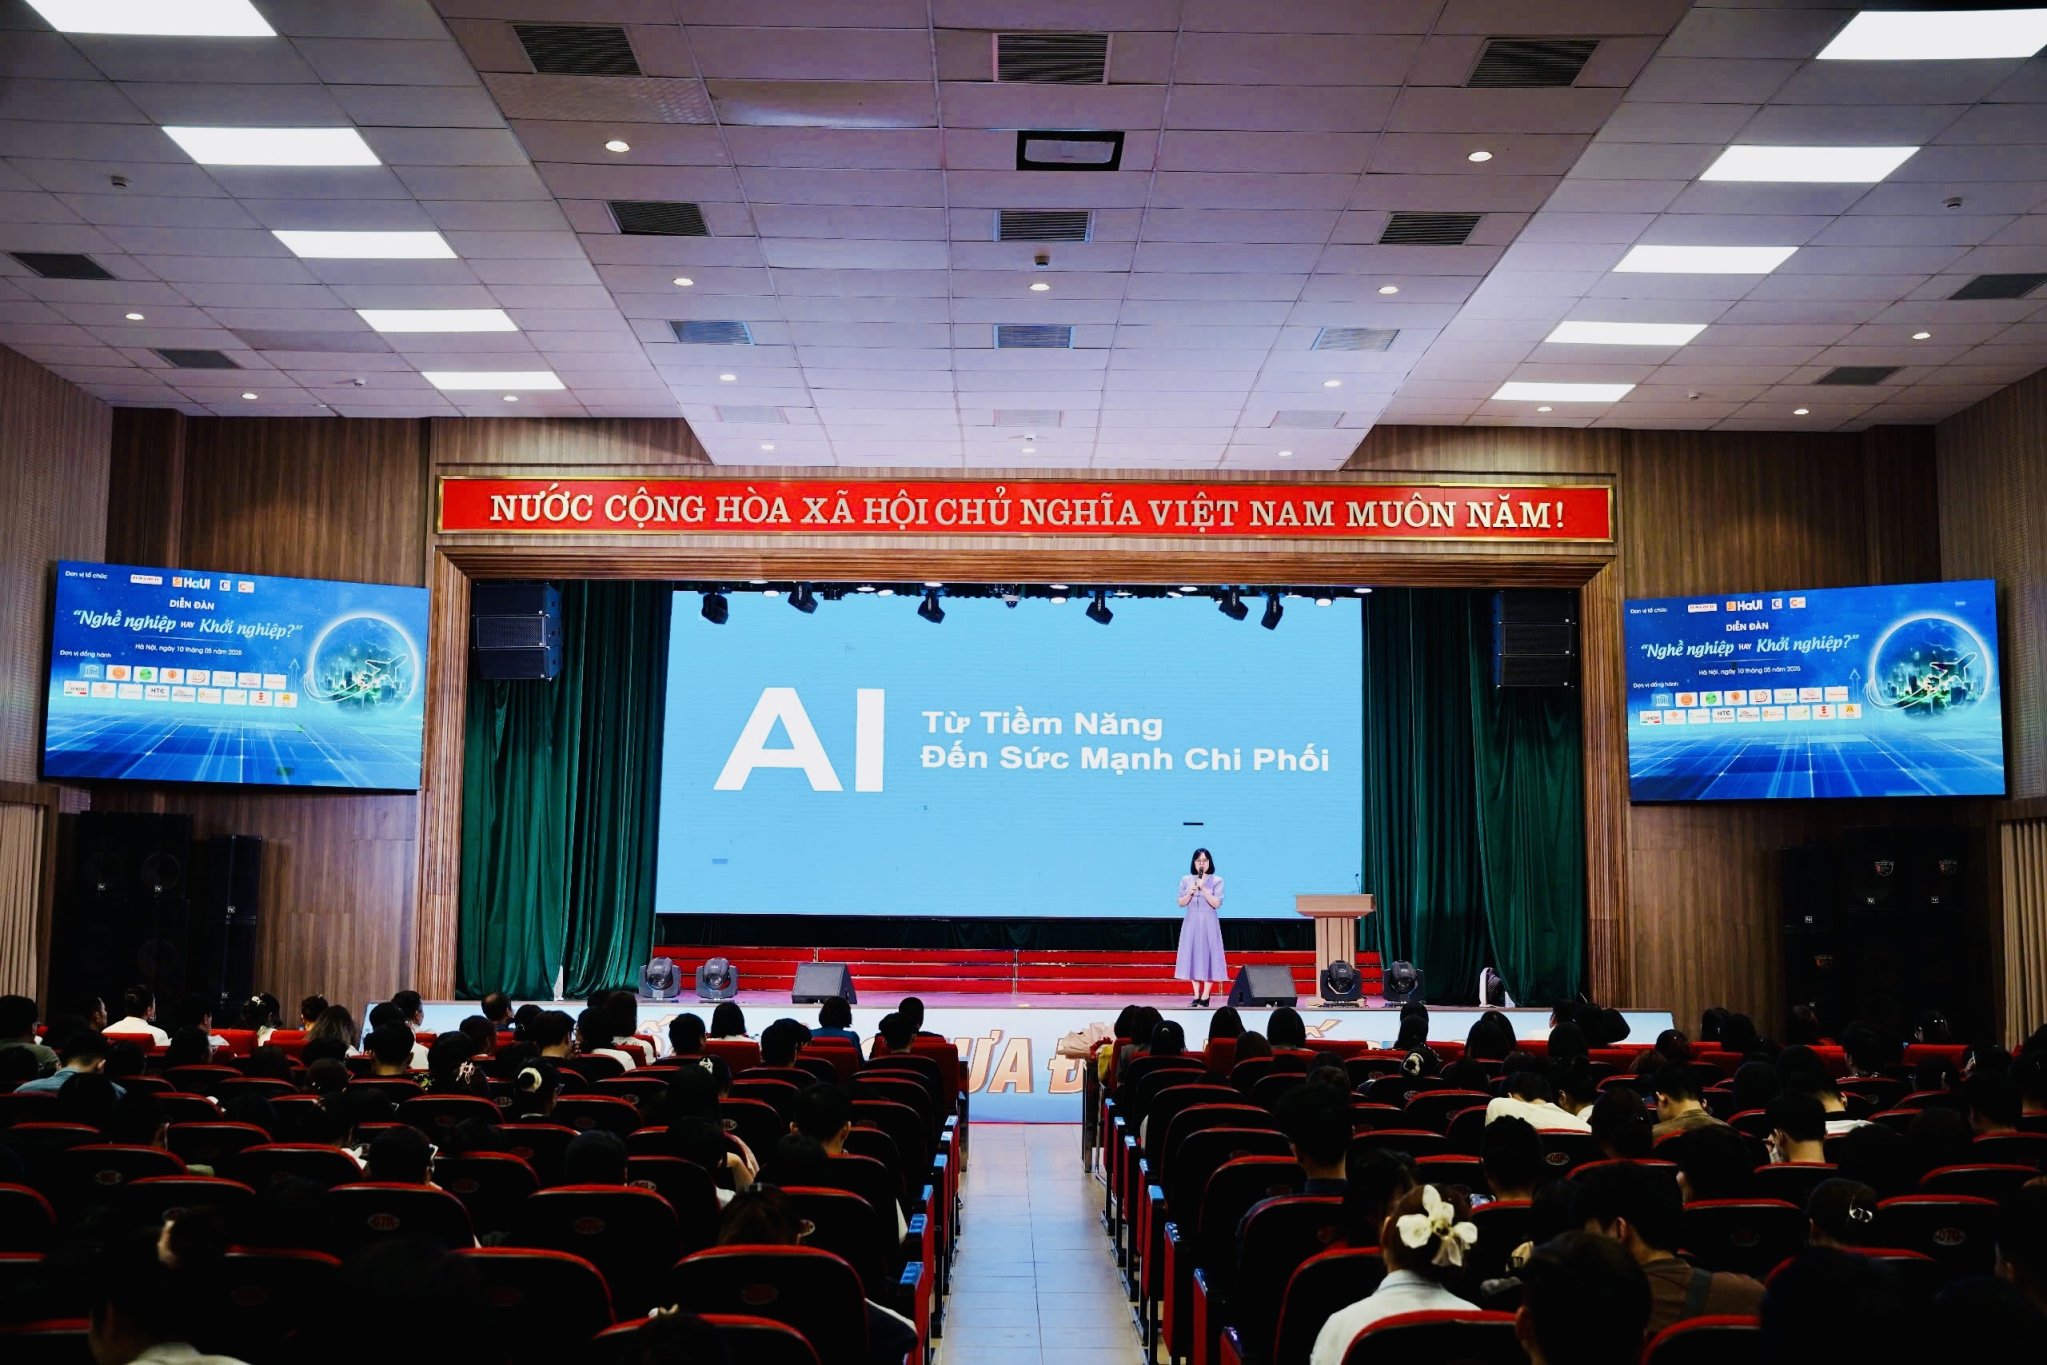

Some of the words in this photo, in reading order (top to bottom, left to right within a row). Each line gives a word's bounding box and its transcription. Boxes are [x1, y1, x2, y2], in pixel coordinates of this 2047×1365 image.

[490, 484, 593, 523] NƯỚC
[605, 488, 707, 530] CỘNG
[716, 486, 791, 523] HÒA
[799, 489, 854, 524] XÃ
[863, 489, 930, 530] HỘI
[935, 485, 1011, 525] CHỦ
[1019, 492, 1140, 526] NGHĨA
[1148, 492, 1239, 533] VIỆT
[1249, 498, 1336, 527] NAM
[1345, 493, 1456, 529] MUÔN
[1466, 493, 1564, 529] NĂM!
[183, 577, 211, 590] HaUI
[169, 597, 192, 609] DIỄN
[194, 599, 215, 610] ĐÀN
[1737, 600, 1763, 612] HaUI
[124, 614, 176, 633] nghiệp
[181, 621, 195, 629] HAY
[200, 617, 234, 634] Khởi
[1726, 620, 1747, 632] DIỄN
[1749, 621, 1769, 631] ĐÀN
[1686, 641, 1734, 658] nghiệp
[1756, 637, 1790, 652] Khởi
[922, 710, 970, 736] Từ
[980, 705, 1062, 736] Tiềm
[1074, 710, 1164, 742] Năng
[713, 687, 885, 792] AI
[920, 740, 988, 770] Đến
[1000, 743, 1070, 771] Sức
[1081, 748, 1174, 776] Mạnh
[1184, 746, 1242, 772] Chi
[1253, 743, 1330, 773] Phối
